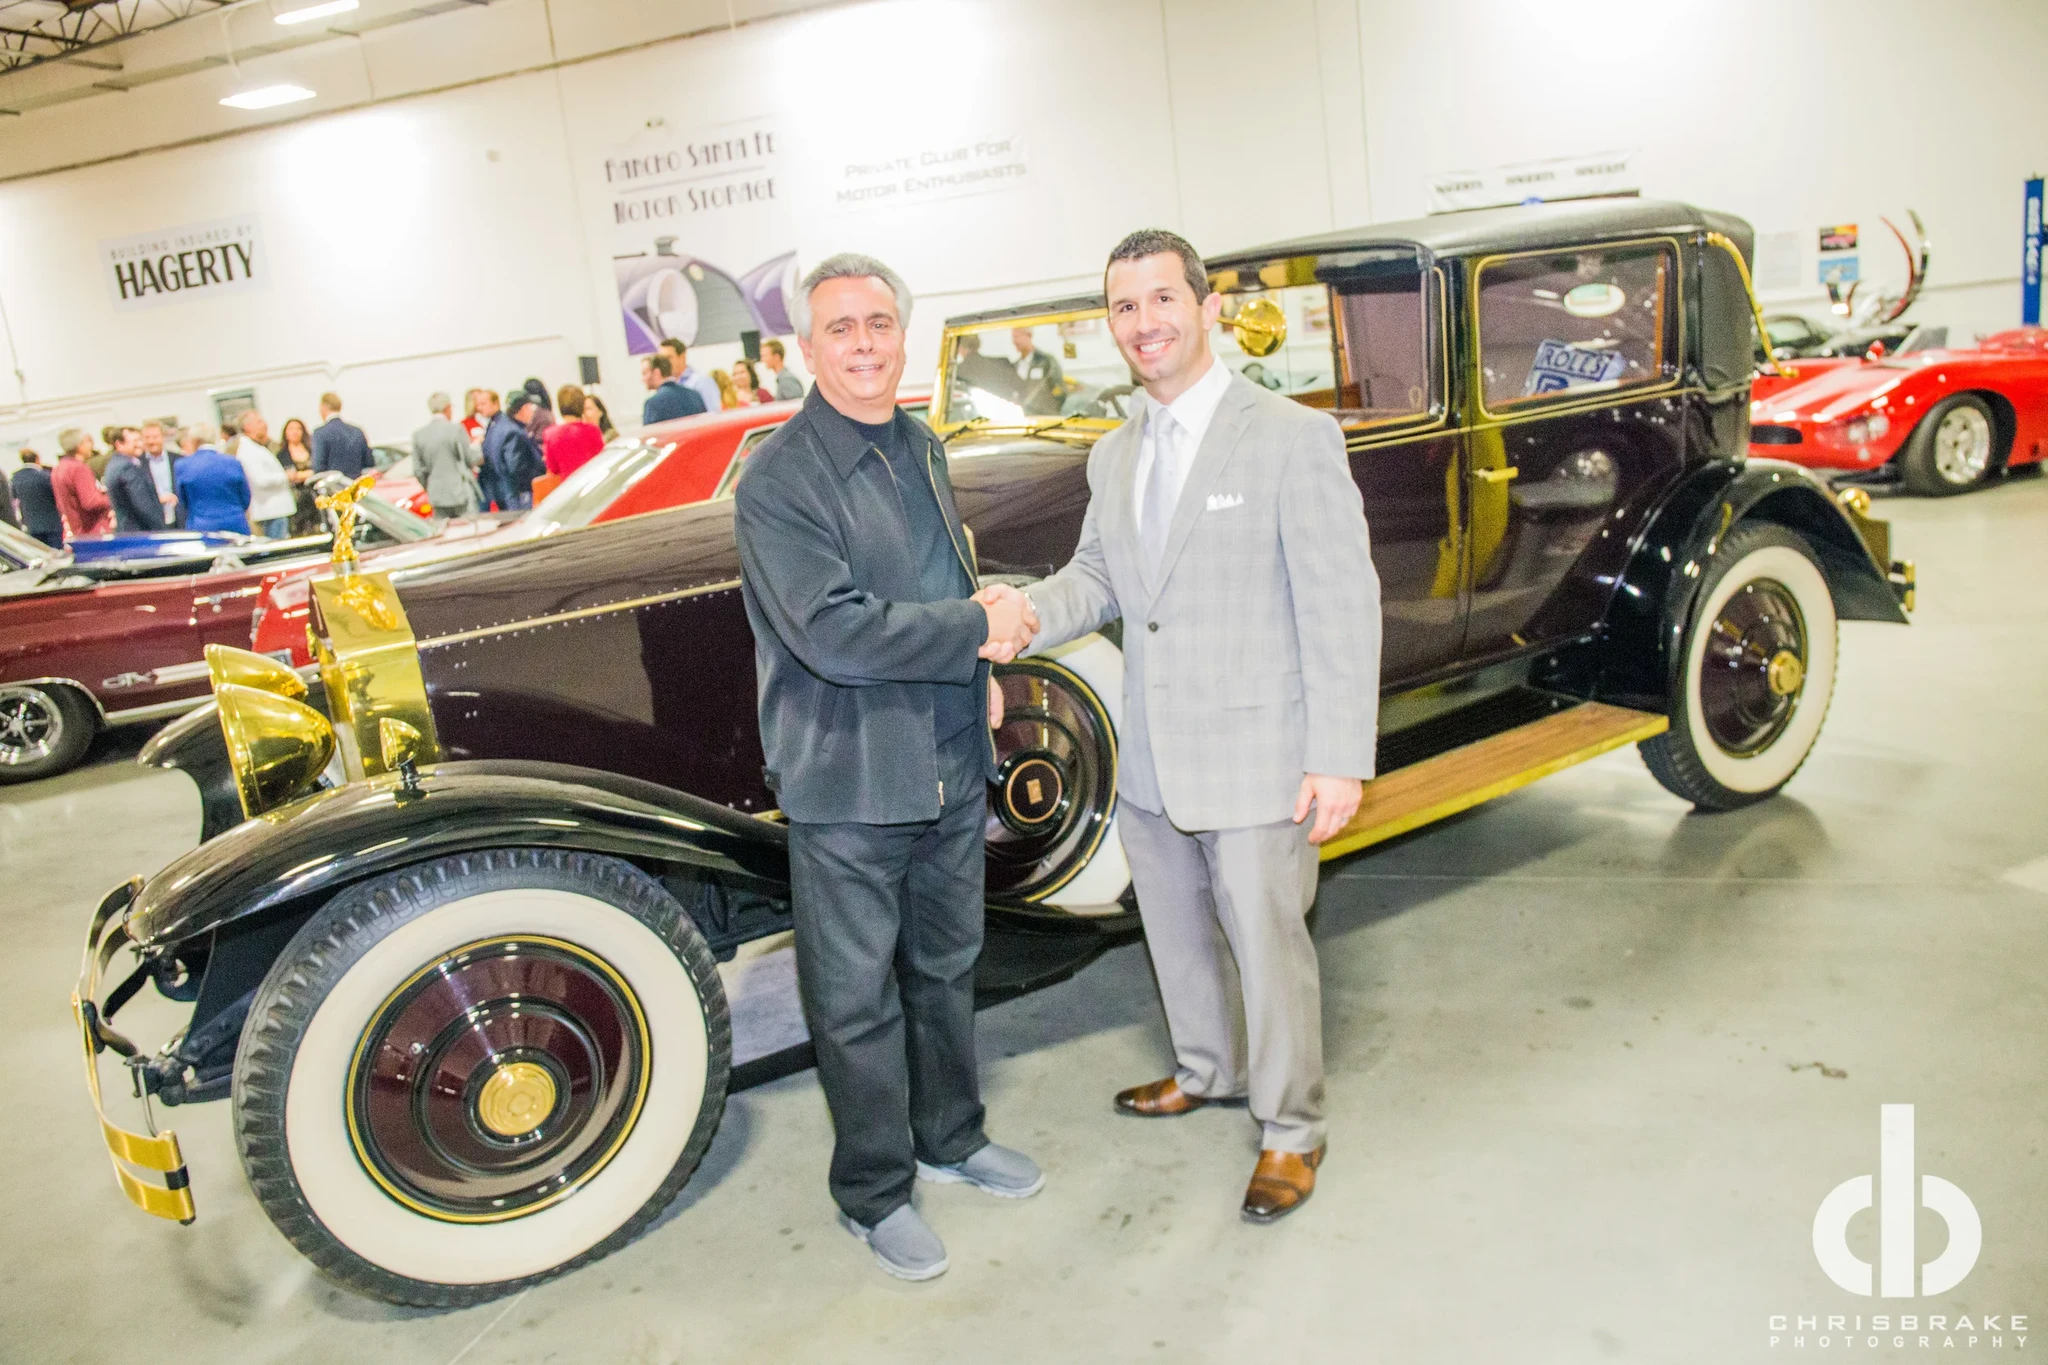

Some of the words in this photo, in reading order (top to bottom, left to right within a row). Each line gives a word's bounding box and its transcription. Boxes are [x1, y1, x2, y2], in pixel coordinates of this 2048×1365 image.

[605, 150, 681, 182] RANCHO
[687, 137, 748, 167] SANTA
[844, 157, 913, 177] PRIVATE
[920, 147, 969, 166] CLUB
[975, 139, 1012, 158] FOR
[614, 195, 683, 224] MOTOR
[688, 178, 777, 211] STORAGE
[836, 184, 898, 203] MOTOR
[904, 162, 1028, 193] ENTHUSIASTS
[114, 240, 253, 300] HAGERTY
[1541, 346, 1605, 376] ROLLS
